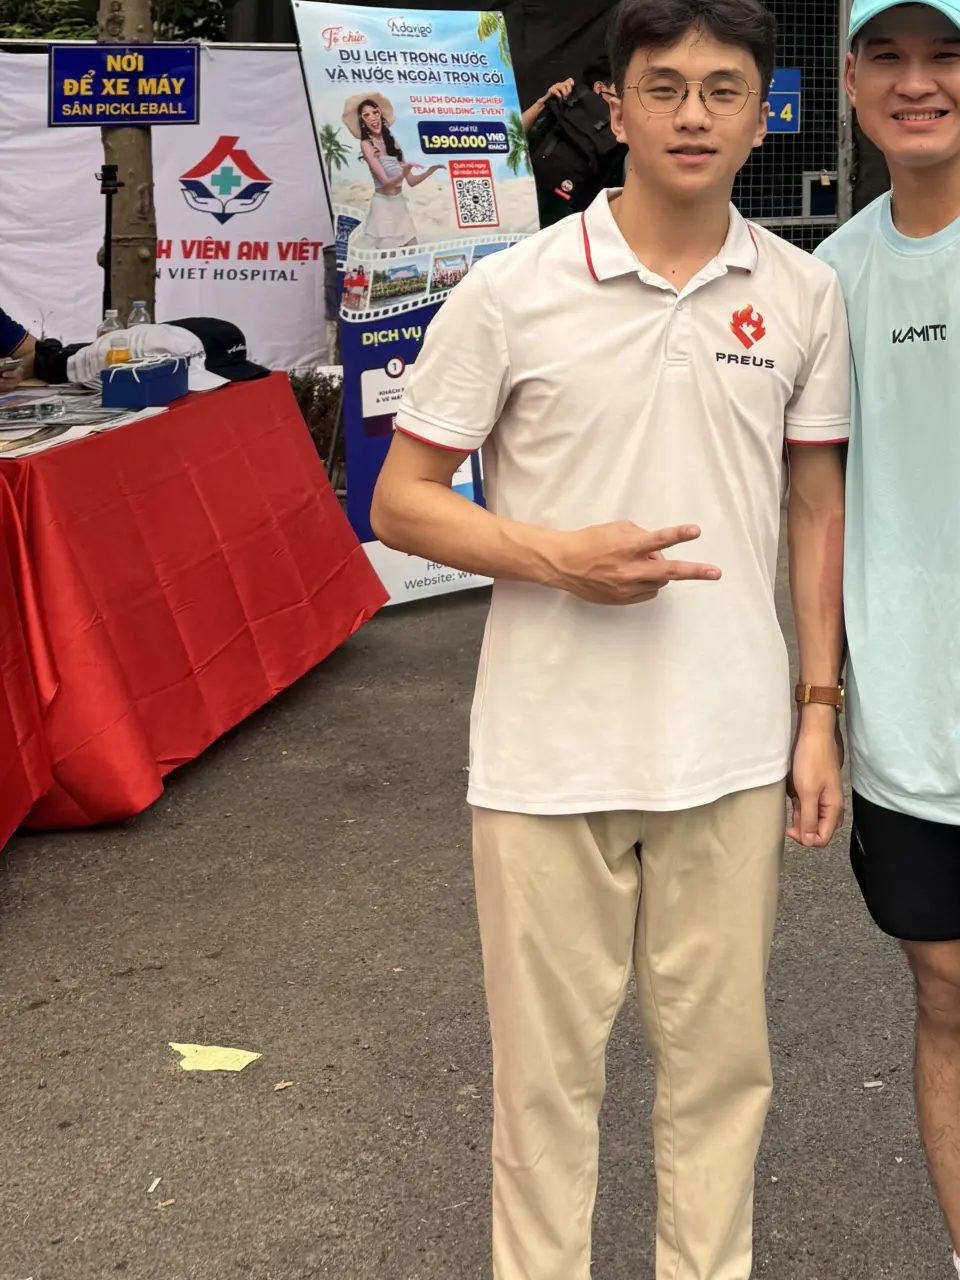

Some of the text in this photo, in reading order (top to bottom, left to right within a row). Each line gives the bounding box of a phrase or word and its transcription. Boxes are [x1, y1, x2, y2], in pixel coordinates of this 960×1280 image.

[390, 19, 432, 37] Adavigo
[106, 52, 144, 72] NƠI
[339, 49, 488, 65] DU LỊCH TRONG NƯỚC
[63, 70, 185, 96] ĐỂ XE MÁY
[325, 65, 504, 88] VÀ NƯỚC NGOÀI TRỌN GÓI
[62, 101, 187, 116] SÂN PICKLEBALL
[410, 95, 422, 104] DU
[424, 96, 443, 105] LỊCH
[444, 97, 474, 105] DOANH
[411, 106, 504, 116] TEAM BUILDING EVENT
[780, 103, 793, 122] 4
[422, 132, 505, 149] 1.990.000 VNĐ
[181, 236, 231, 265] VIỆN
[237, 241, 269, 261] AN
[276, 237, 323, 266] VIỆT
[168, 268, 207, 280] VIET
[213, 269, 299, 281] HOSPITAL
[362, 326, 422, 348] DỊCH VỤ
[715, 352, 775, 369] PREUS
[404, 571, 456, 590] Website:
